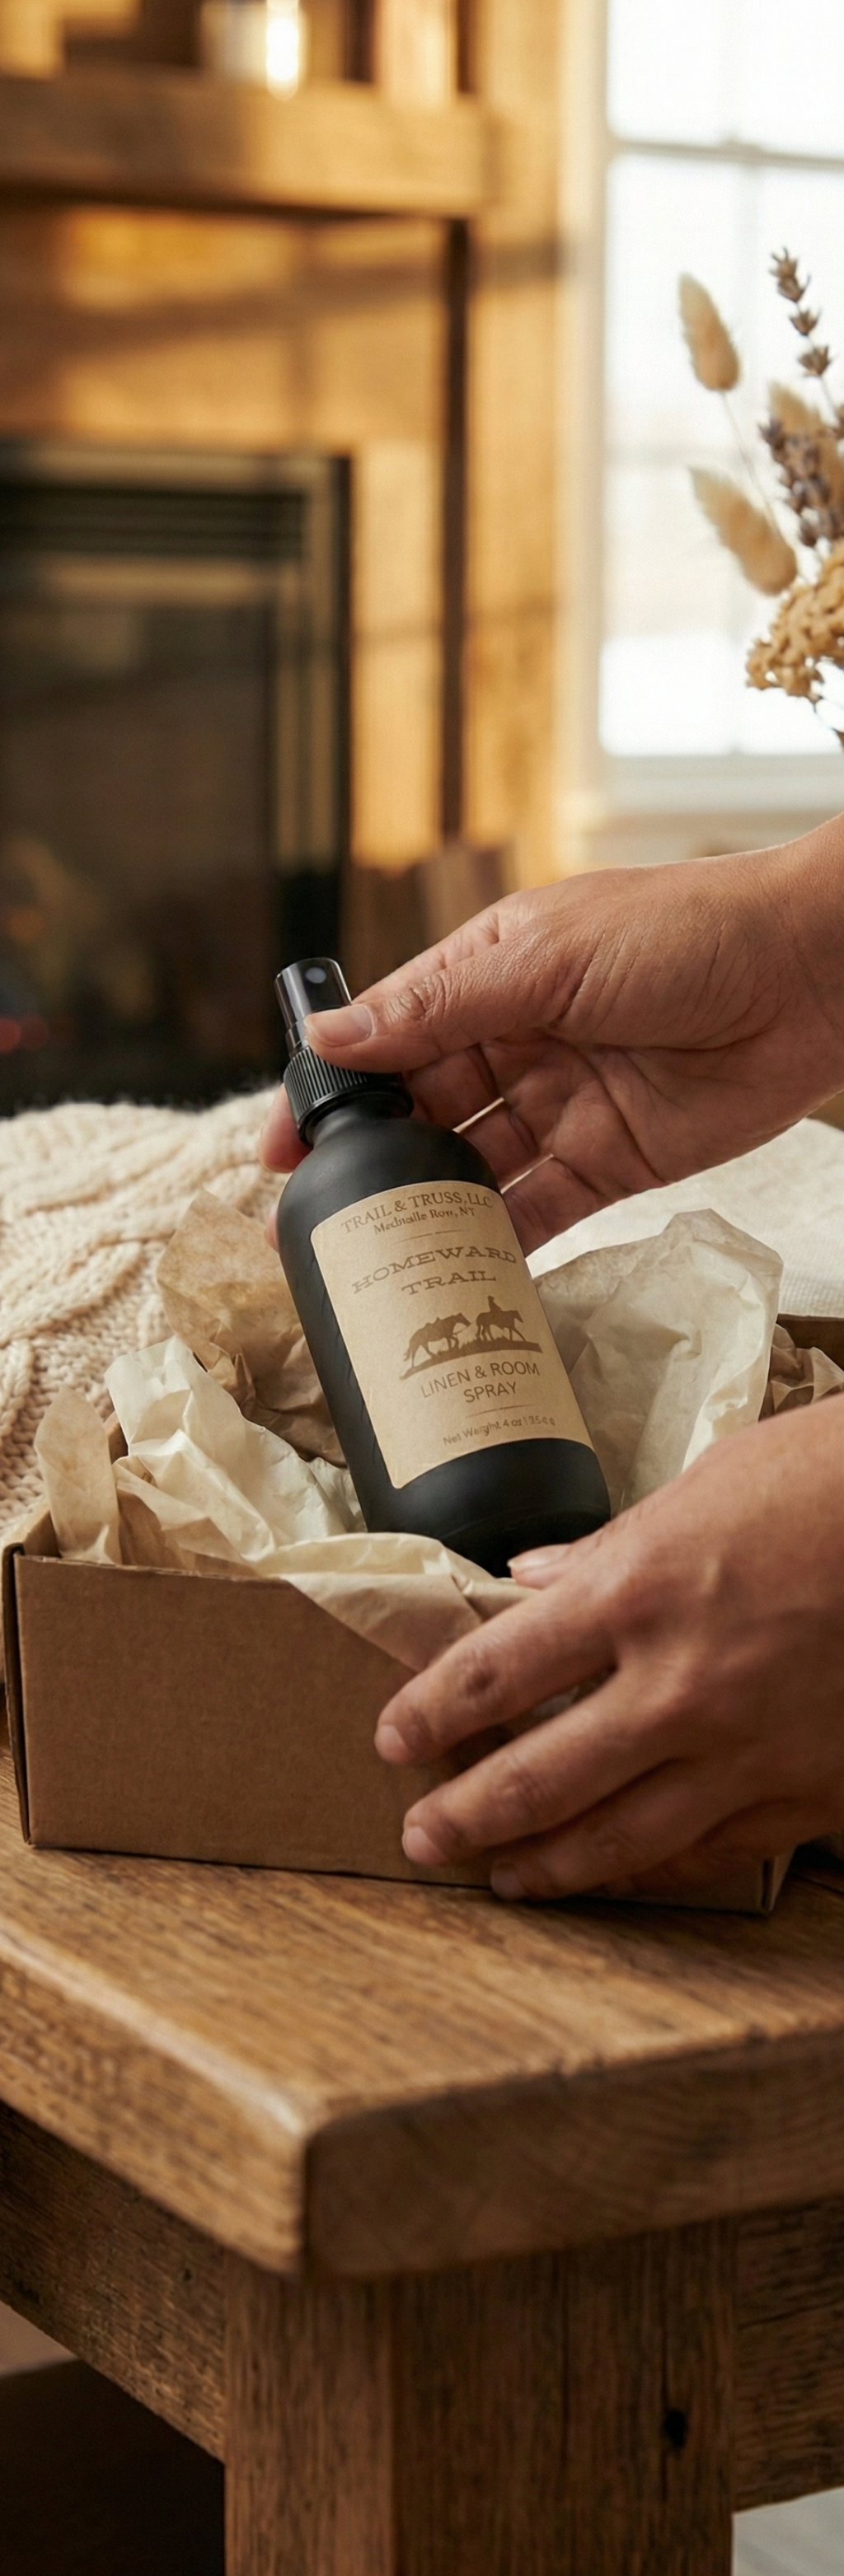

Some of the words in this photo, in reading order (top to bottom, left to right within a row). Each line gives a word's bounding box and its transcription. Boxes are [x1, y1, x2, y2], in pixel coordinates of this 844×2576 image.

[340, 1207, 392, 1234] TRAIL
[394, 1199, 407, 1213] &
[351, 1246, 517, 1294] HOMEWARD
[401, 1271, 496, 1295] TRAIL
[420, 1368, 471, 1398] LINEN
[475, 1365, 487, 1379] &
[490, 1361, 541, 1377] ROOM
[463, 1381, 517, 1403] SPRAY
